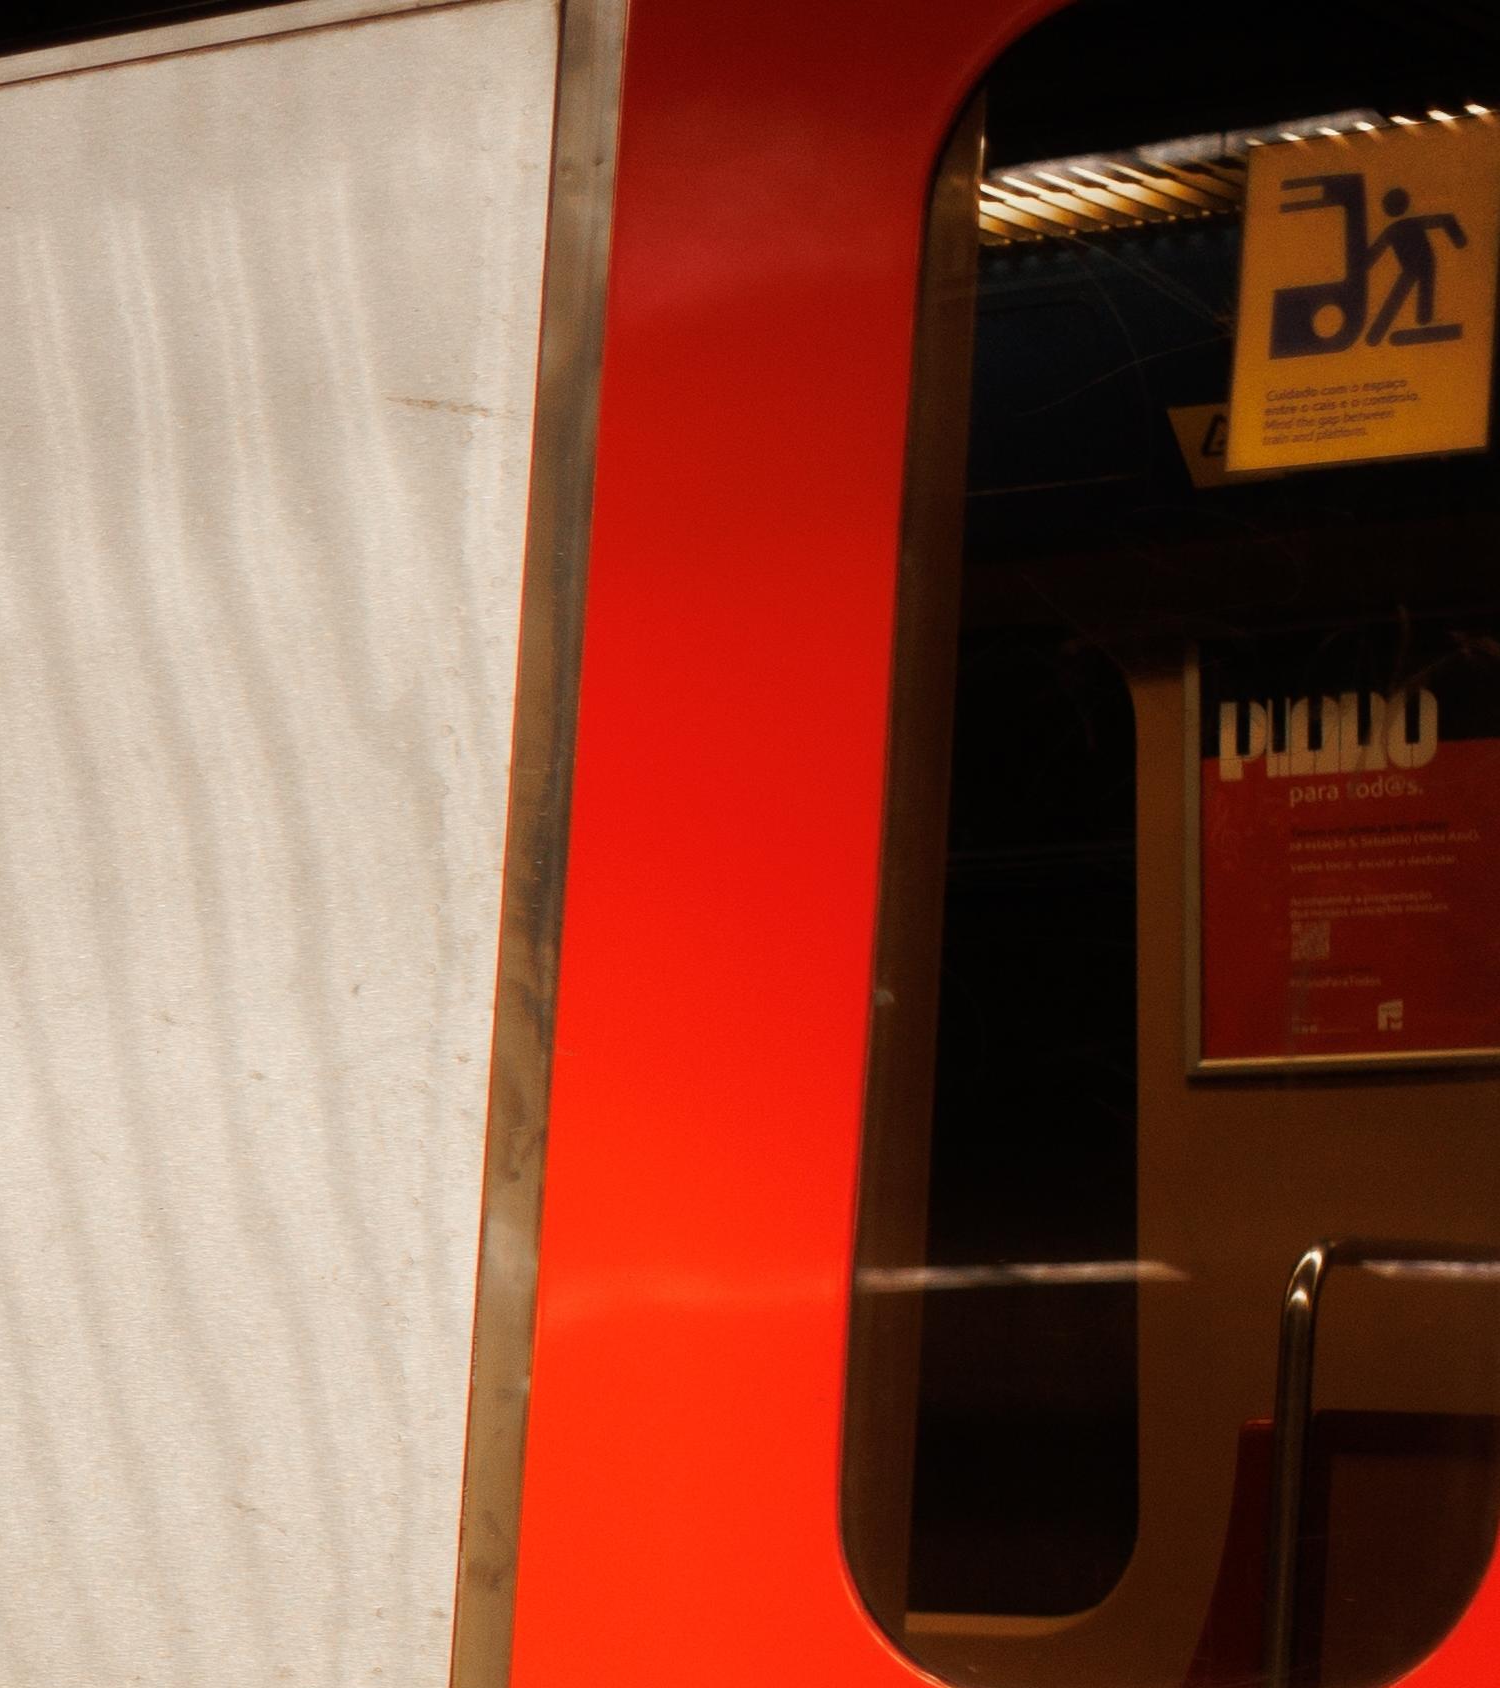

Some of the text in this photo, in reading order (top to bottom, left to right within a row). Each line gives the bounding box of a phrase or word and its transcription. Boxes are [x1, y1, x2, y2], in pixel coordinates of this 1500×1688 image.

[1266, 387, 1318, 401] Cuidado
[1312, 399, 1336, 411] cais
[1219, 687, 1439, 783] PIANO
[1289, 783, 1339, 808] para
